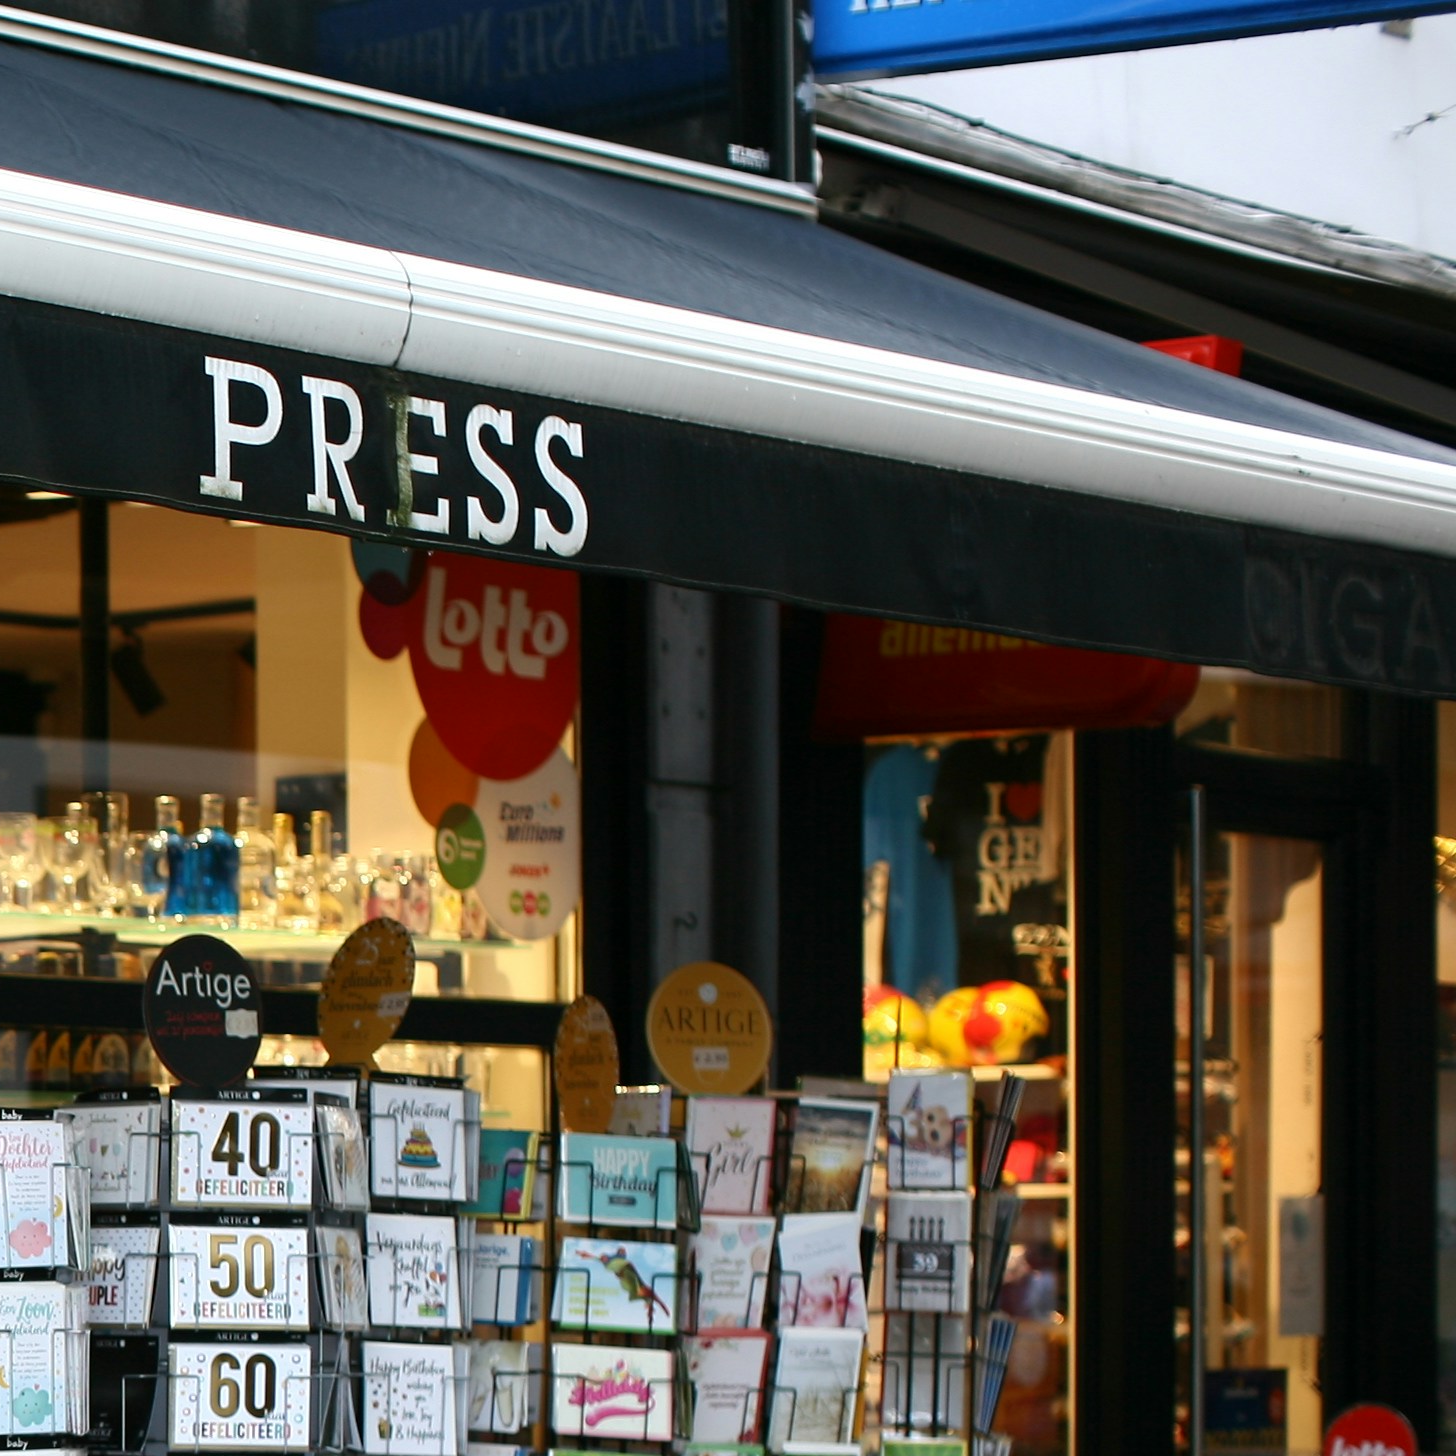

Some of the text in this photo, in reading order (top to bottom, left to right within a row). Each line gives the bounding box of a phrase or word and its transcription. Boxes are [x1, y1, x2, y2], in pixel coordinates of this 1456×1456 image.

[199, 356, 587, 558] PRESS
[423, 567, 568, 679] lotto
[156, 960, 252, 1009] Artige
[658, 1006, 762, 1036] ARTIGE
[1, 1109, 23, 1121] baby
[211, 1110, 282, 1176] 40
[592, 1147, 651, 1177] HAPPY
[195, 1179, 295, 1196] GEFELICITEERD
[589, 1172, 658, 1200] Birthday
[3, 1269, 25, 1280] baby
[209, 1233, 276, 1299] 50
[193, 1302, 292, 1320] GEFELICITEERD
[209, 1351, 277, 1418] 60
[6, 1437, 29, 1450] baby
[192, 1421, 291, 1439] GEFELICITEERD
